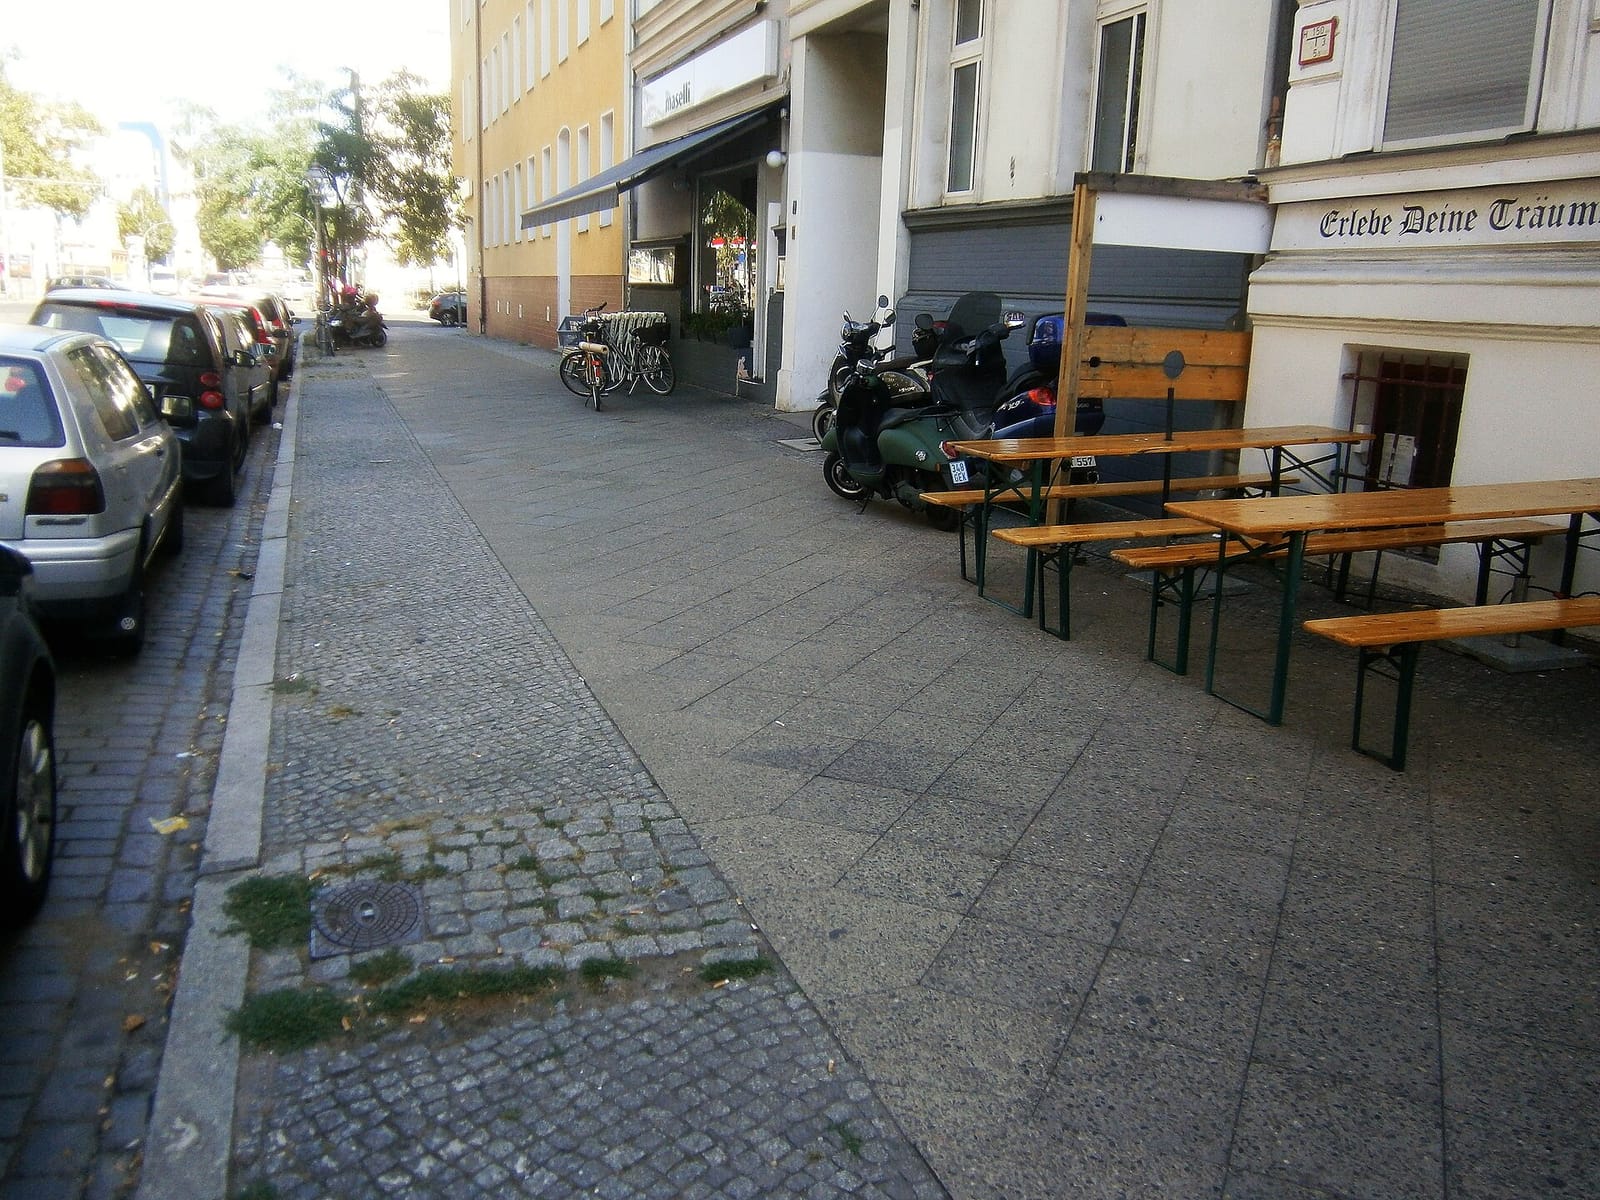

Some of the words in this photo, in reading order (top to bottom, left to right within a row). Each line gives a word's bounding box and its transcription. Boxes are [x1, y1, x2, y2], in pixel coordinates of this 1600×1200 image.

[1320, 208, 1393, 238] Erlebe
[1399, 204, 1478, 237] Deine
[1489, 196, 1600, 231] Träum
